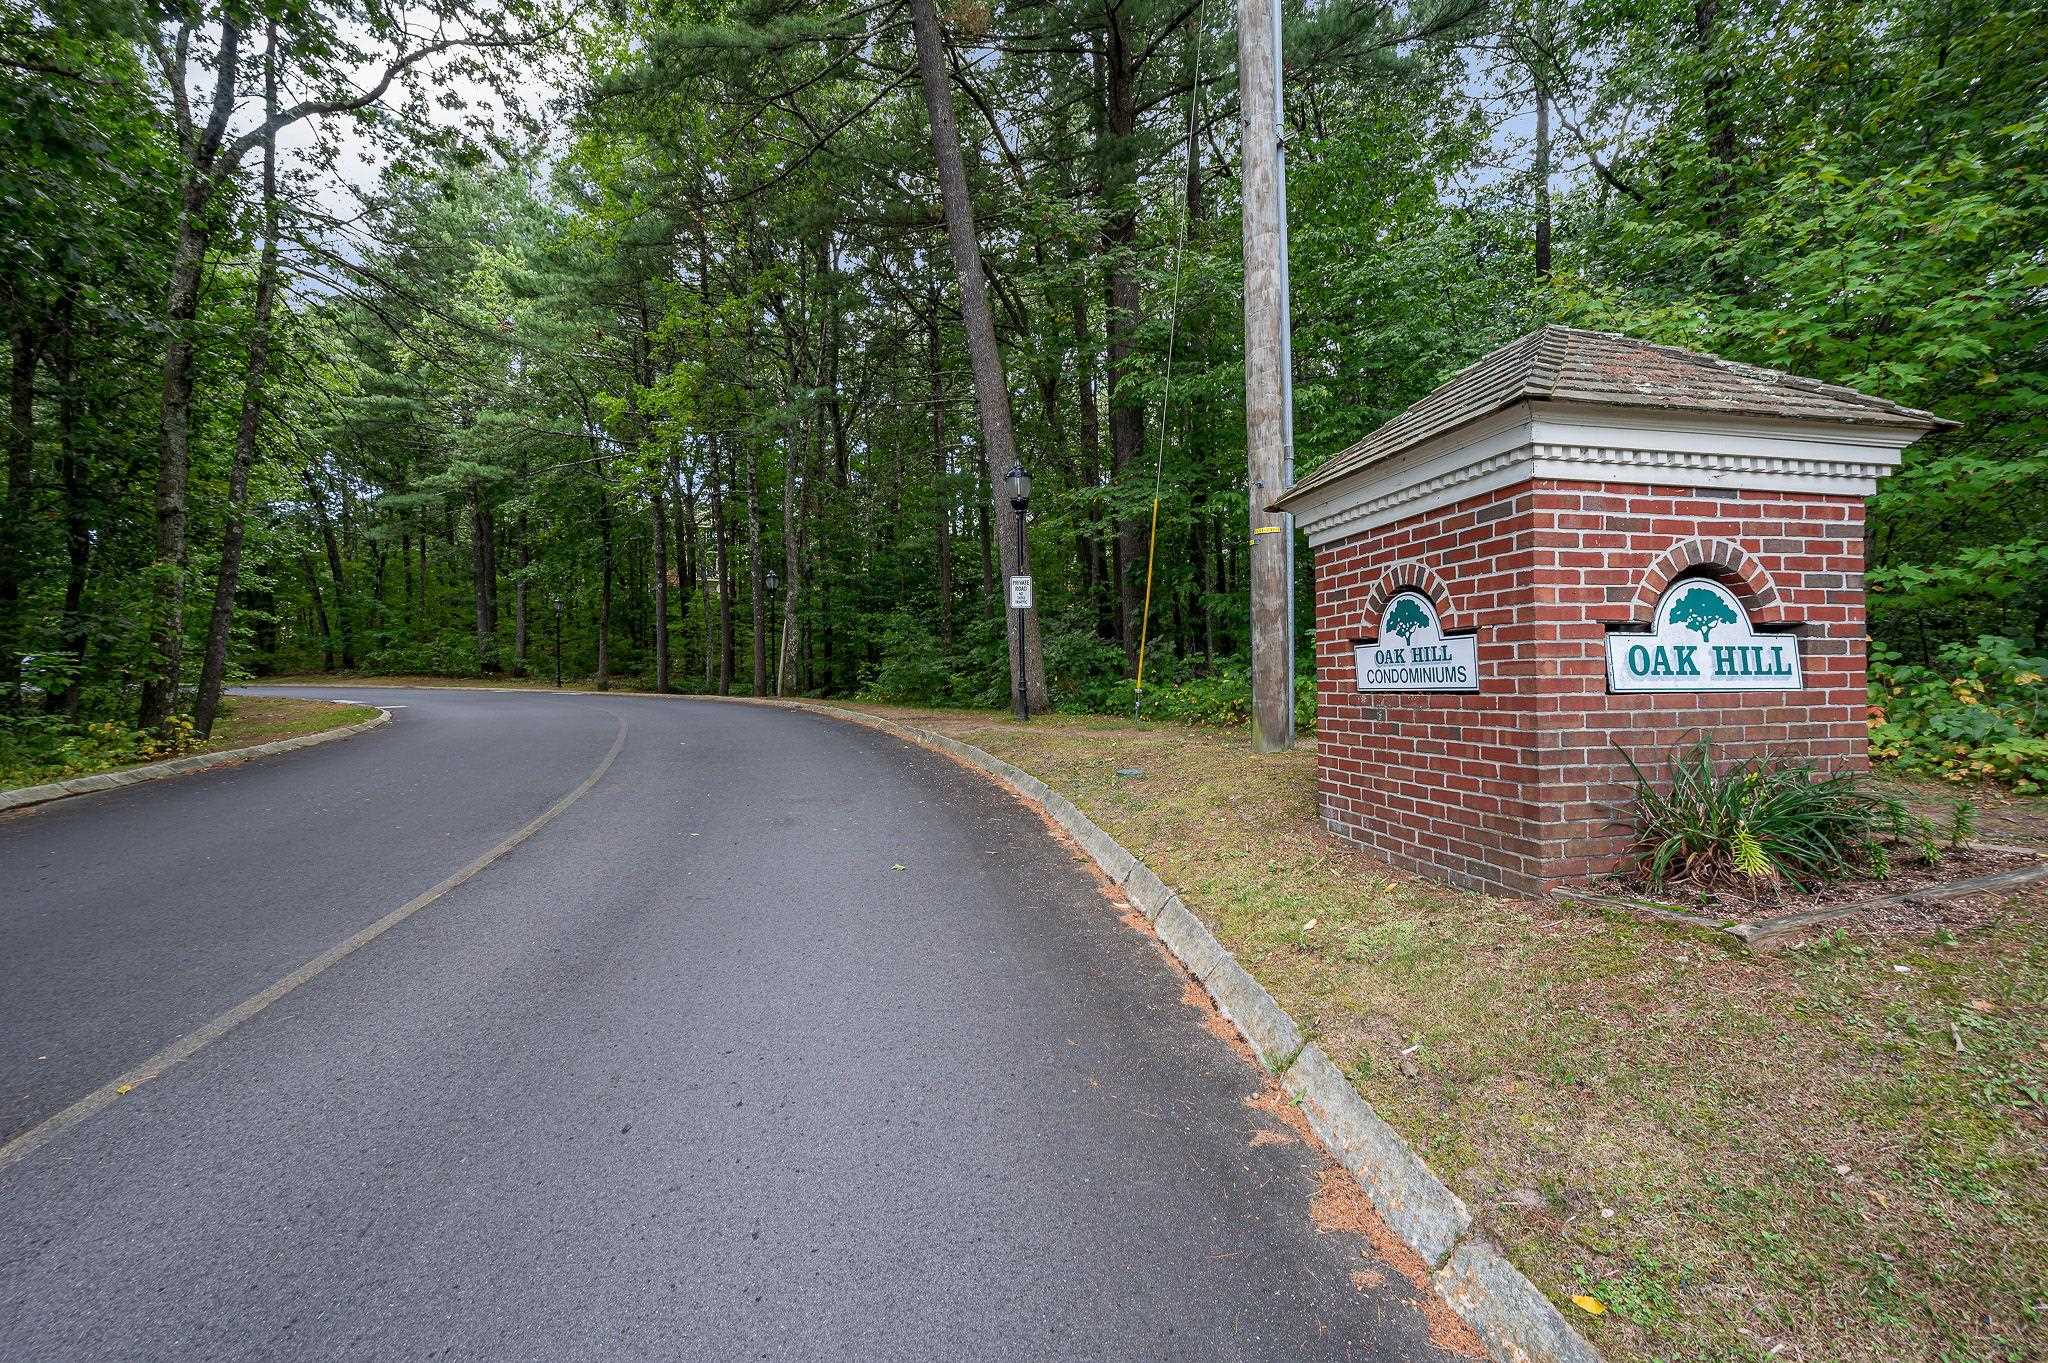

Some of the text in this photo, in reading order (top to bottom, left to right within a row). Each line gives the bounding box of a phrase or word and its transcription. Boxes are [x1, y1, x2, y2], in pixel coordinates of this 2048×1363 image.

[1375, 645, 1453, 665] OAK HILL
[1628, 644, 1792, 676] OAK HILL
[1366, 666, 1467, 684] CONDOMINIUMS
